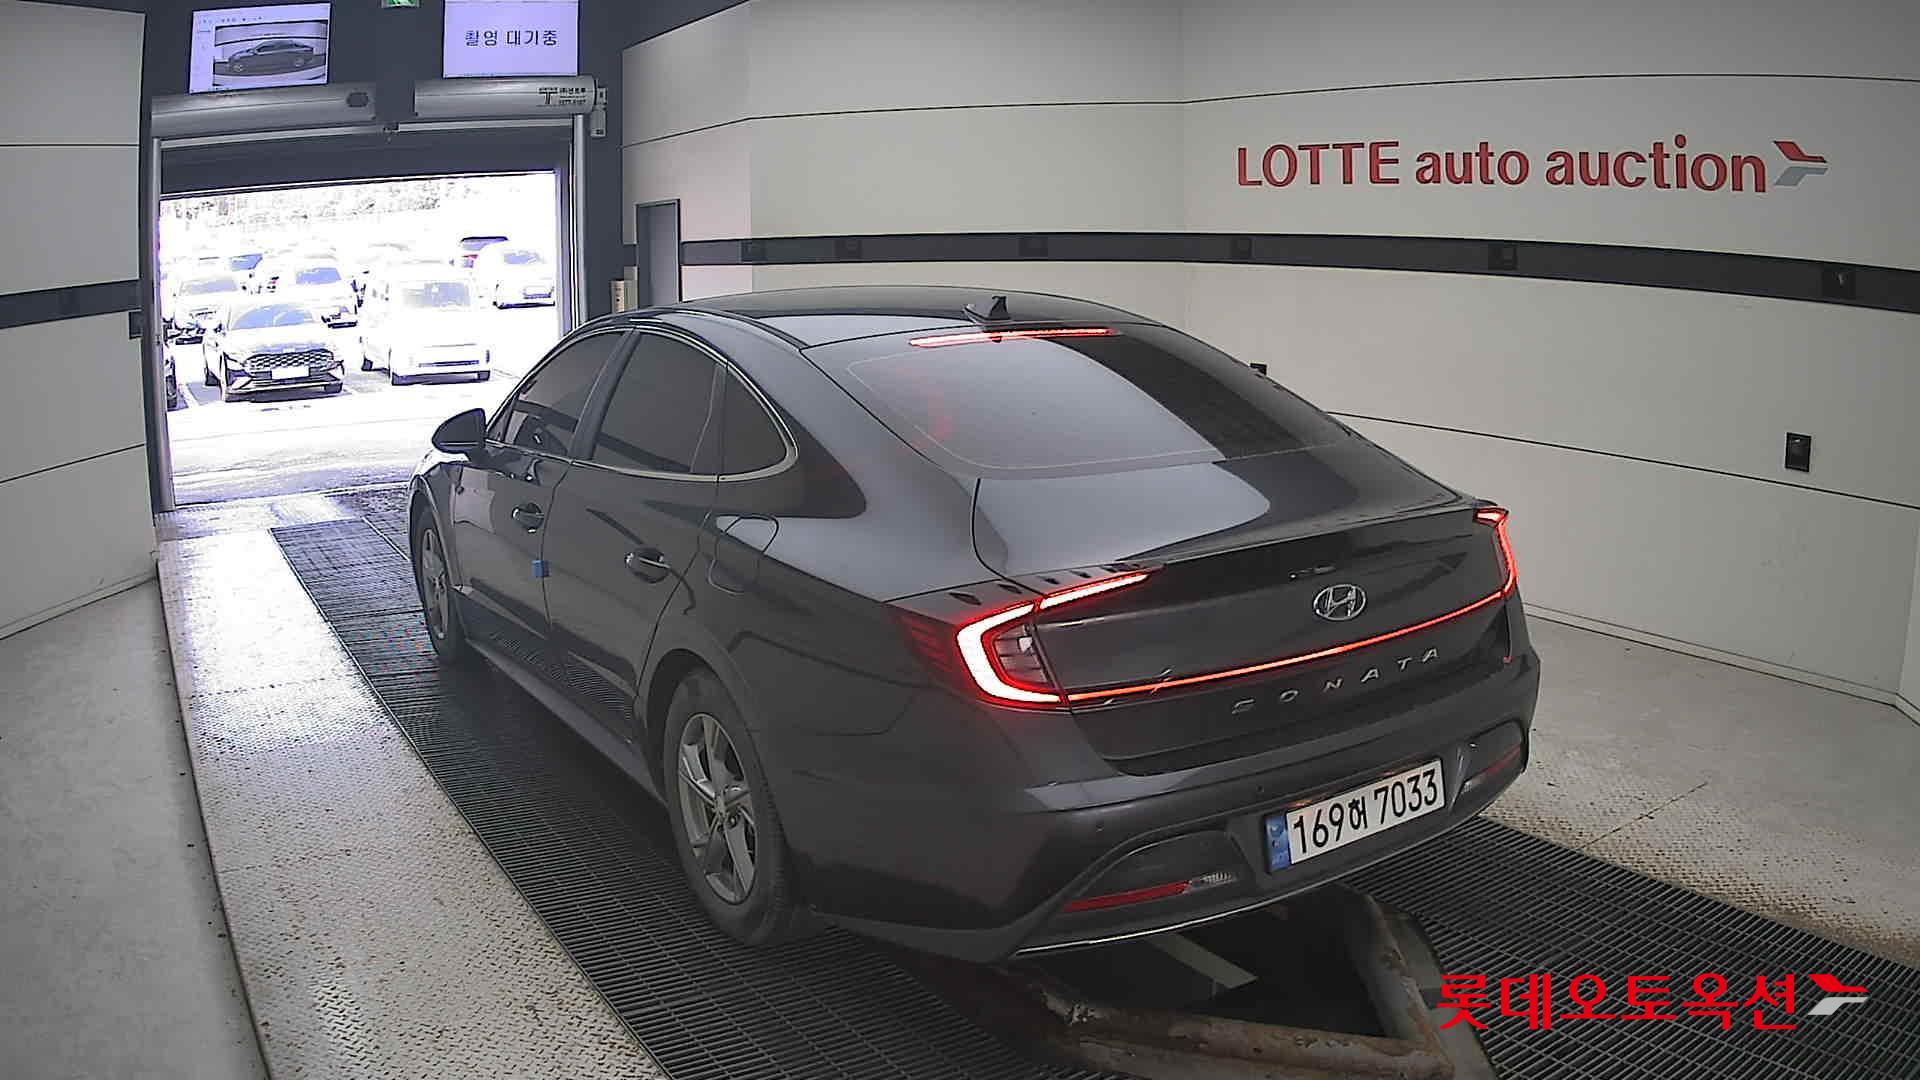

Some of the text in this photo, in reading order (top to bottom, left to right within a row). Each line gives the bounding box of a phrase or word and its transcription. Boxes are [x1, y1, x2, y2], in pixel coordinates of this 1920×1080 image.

[465, 30, 557, 46] 촬영 대기중
[1237, 134, 1767, 192] LOTTE auto auction
[1232, 648, 1439, 714] SONATA
[1293, 768, 1438, 854] 169허 7033
